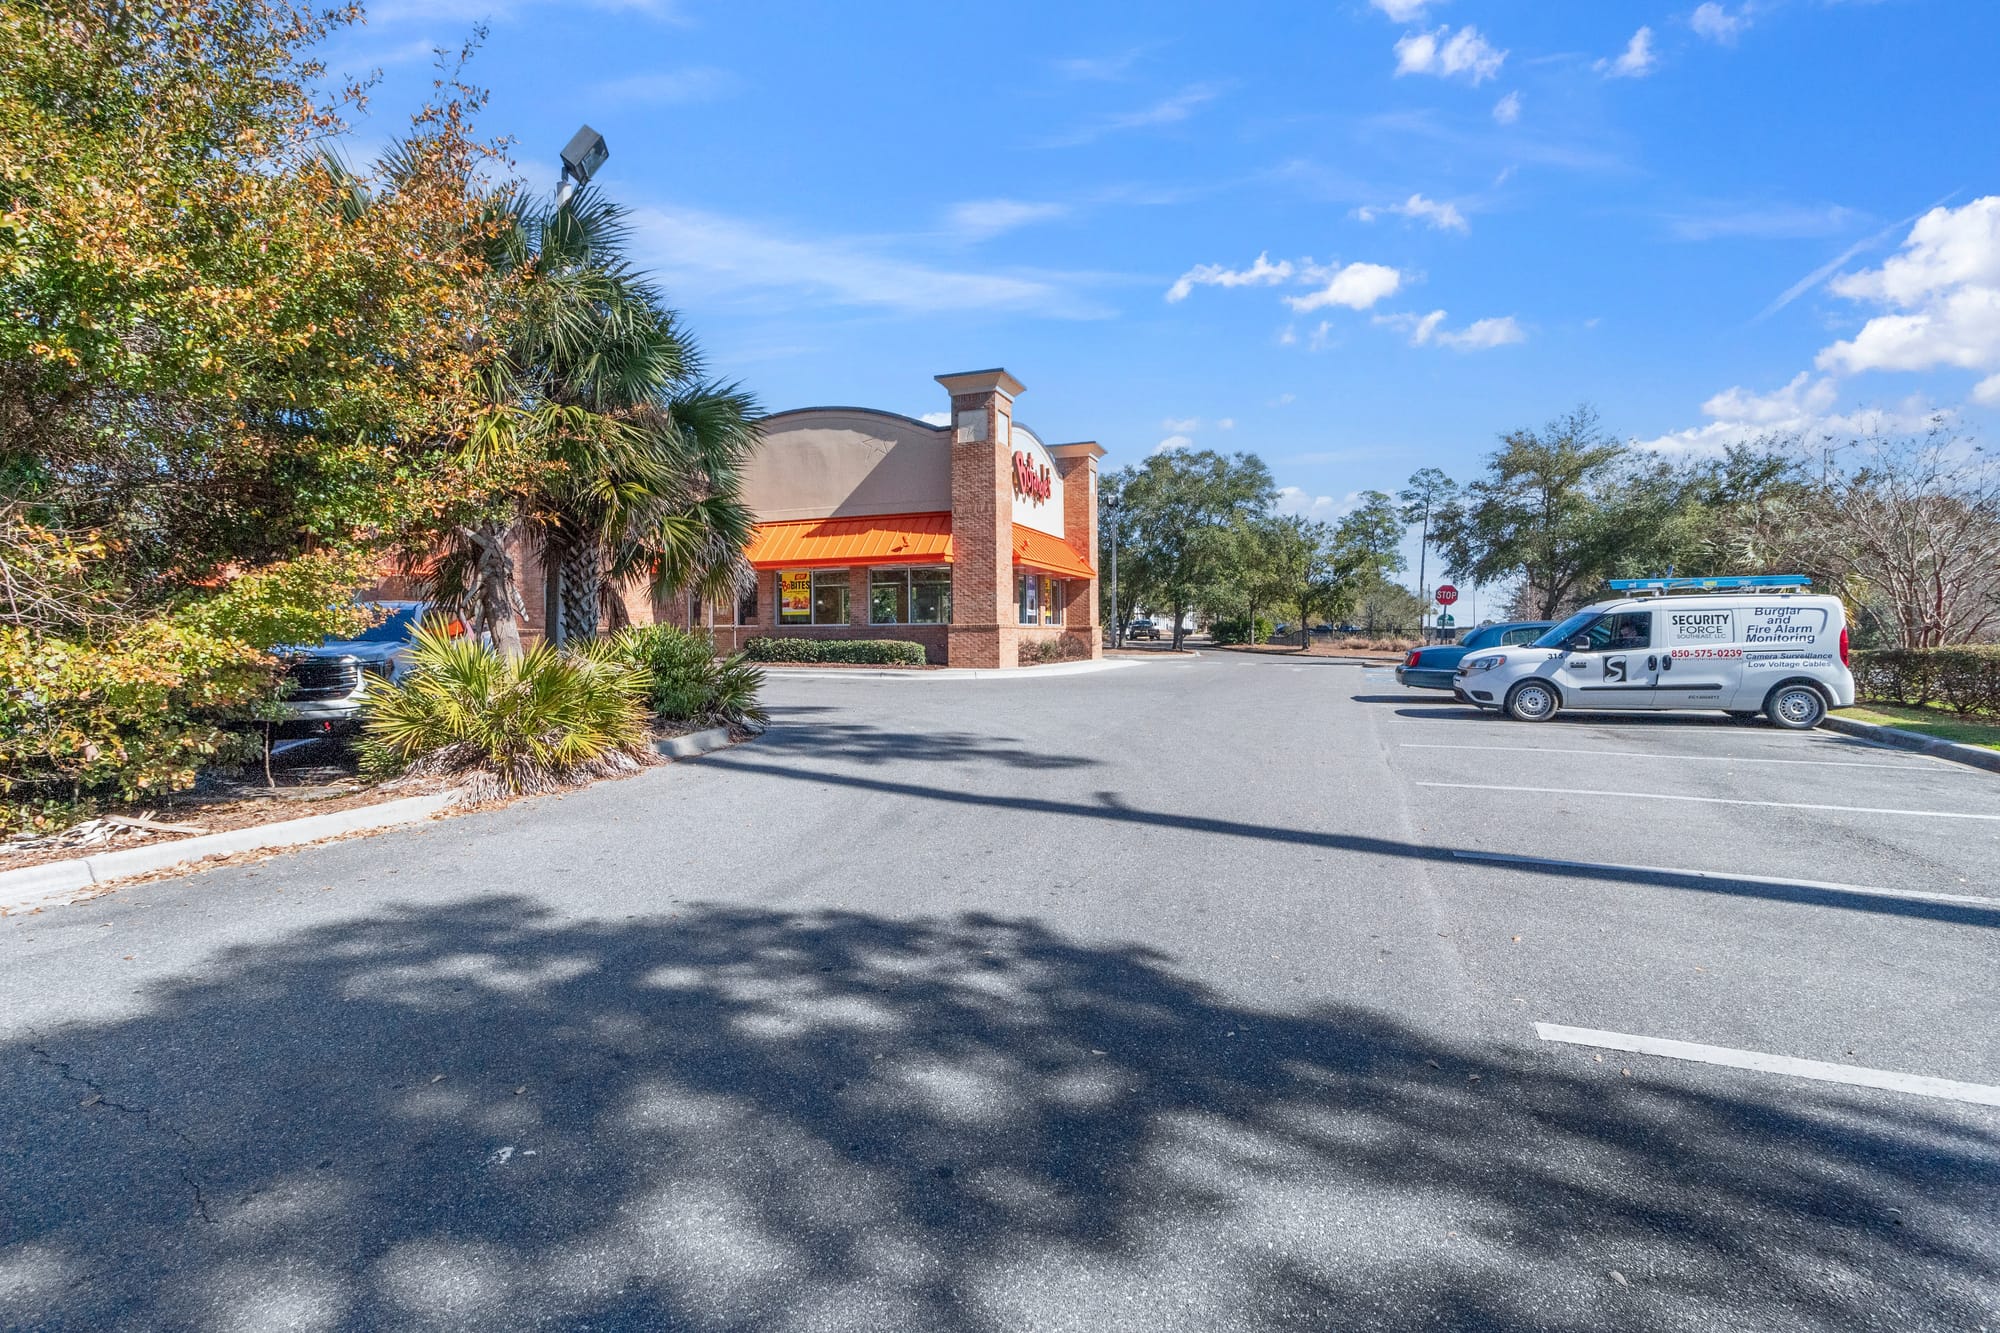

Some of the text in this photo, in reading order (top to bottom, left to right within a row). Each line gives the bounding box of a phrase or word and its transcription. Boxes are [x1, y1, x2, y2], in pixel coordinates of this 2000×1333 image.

[1436, 590, 1457, 599] STOP
[1754, 607, 1801, 617] Burglar
[1672, 614, 1729, 625] SECURITY
[1767, 616, 1791, 625] and
[1679, 626, 1723, 634] FORCE
[1746, 625, 1813, 634] Fire Alarm
[1745, 634, 1815, 644] Monitoring
[1671, 650, 1742, 658] 850-575-0239
